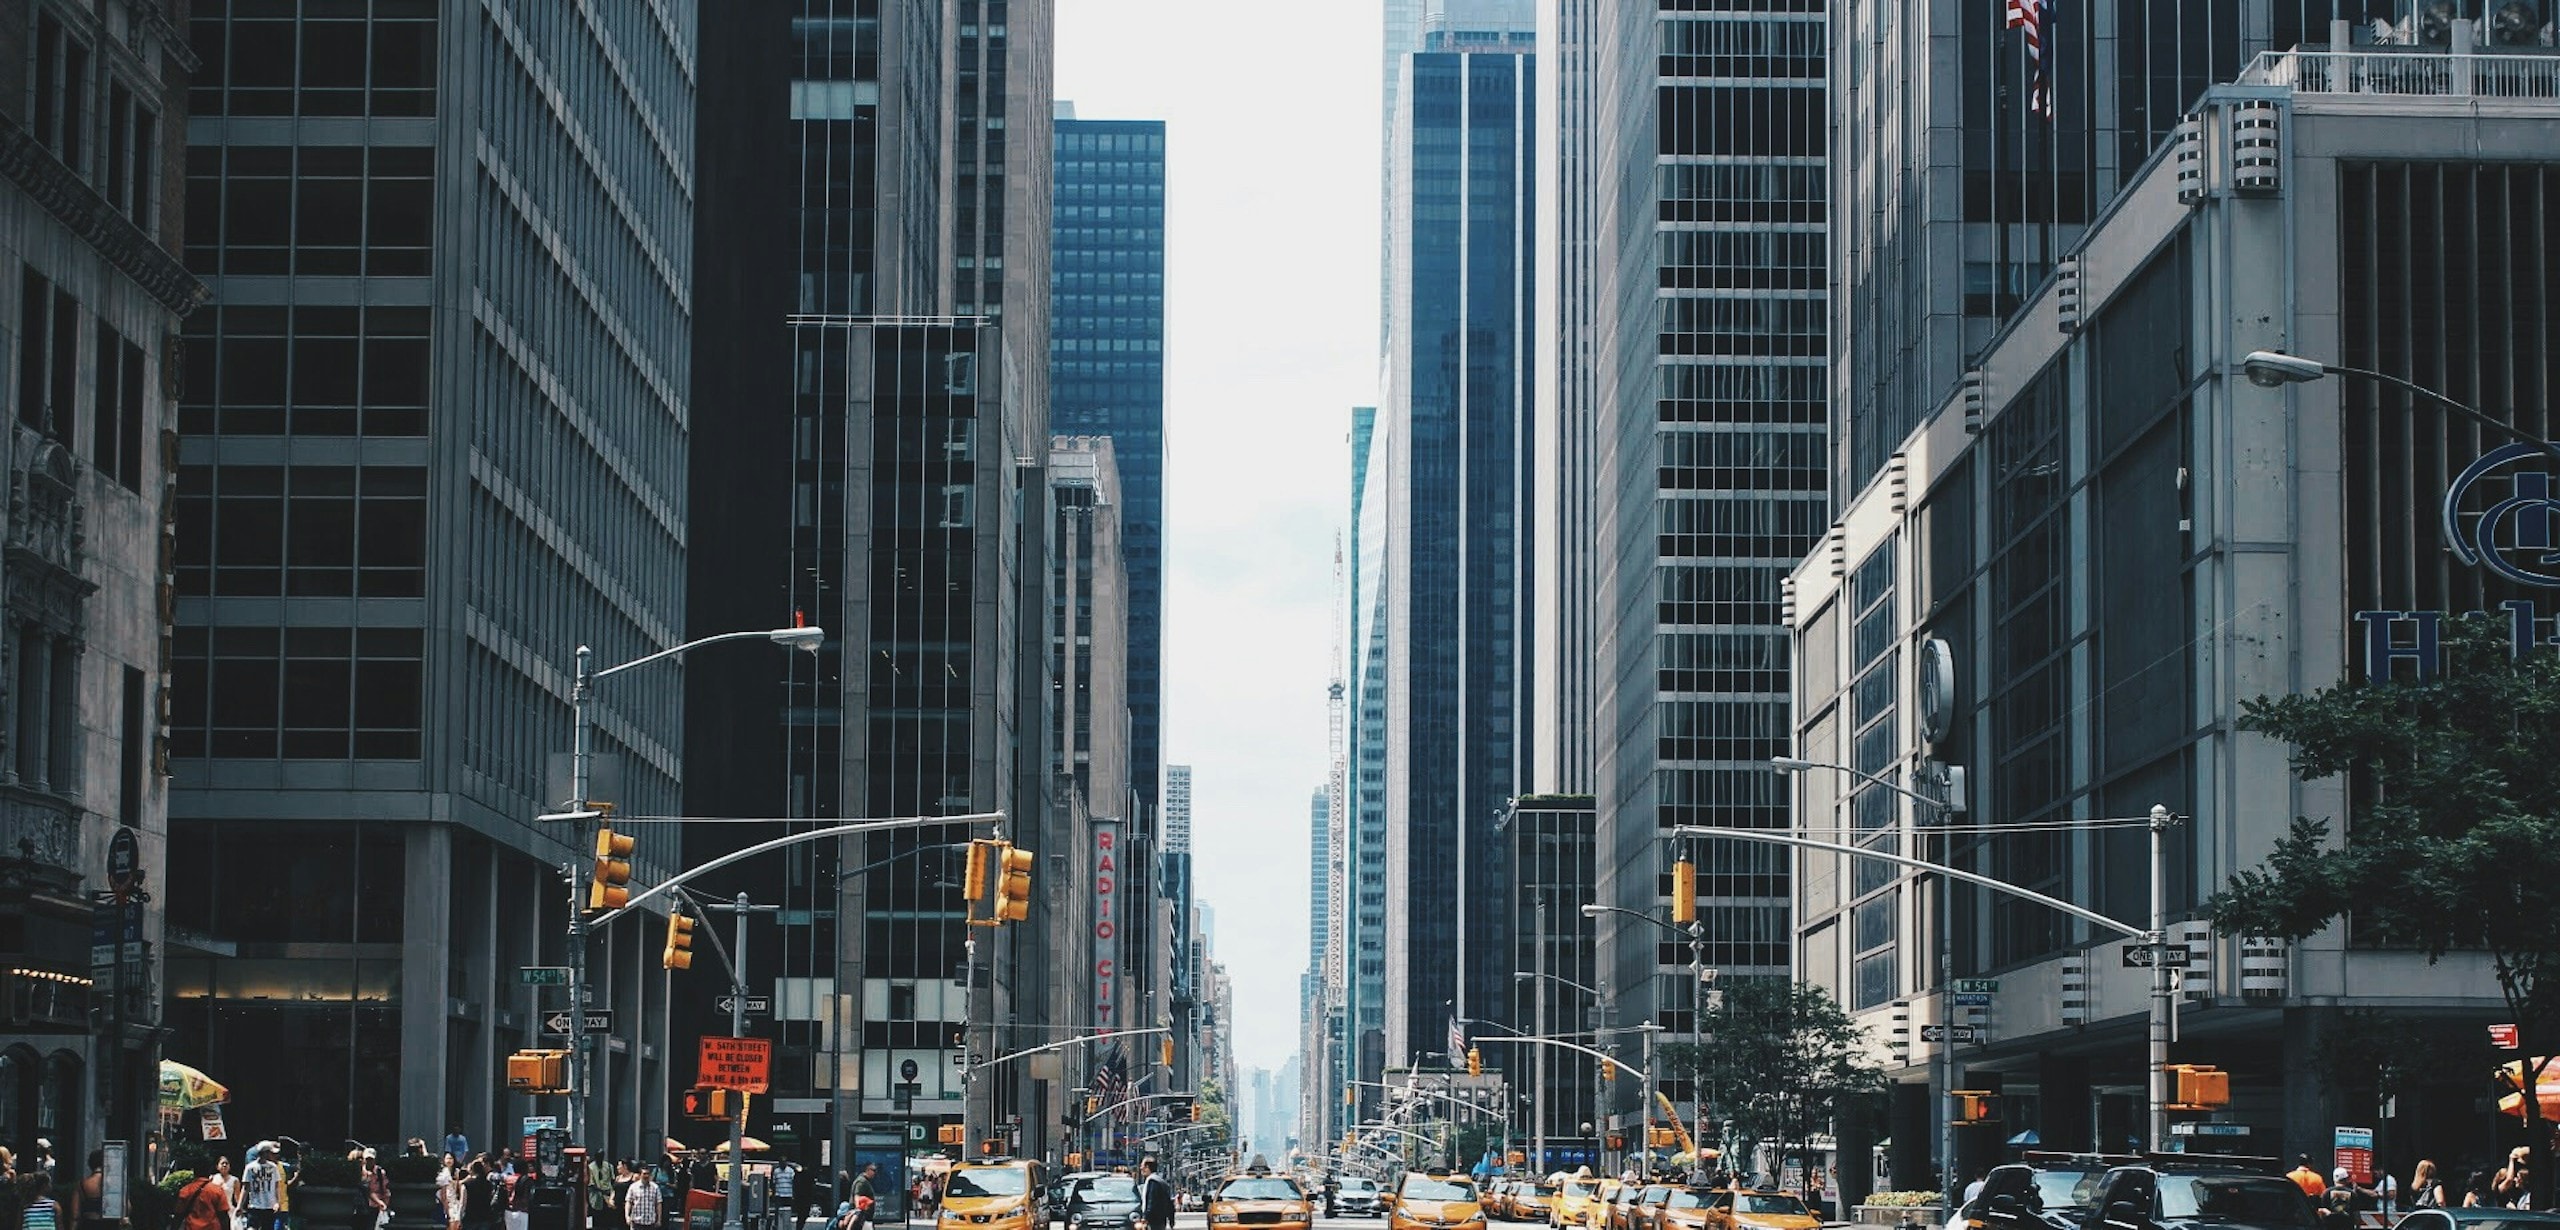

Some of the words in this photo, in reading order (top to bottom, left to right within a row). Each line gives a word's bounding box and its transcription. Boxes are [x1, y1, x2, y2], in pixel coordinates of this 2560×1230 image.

[1096, 833, 1114, 938] RADIO
[2133, 952, 2153, 961] ONE
[2165, 952, 2181, 961] AY
[523, 970, 531, 982] W
[533, 970, 546, 983] 54
[1975, 981, 1987, 992] 54
[1096, 960, 1113, 1045] CITY
[555, 1018, 570, 1028] ON
[738, 1043, 767, 1052] STREET
[708, 1053, 723, 1061] WILL
[725, 1053, 735, 1062] BE
[736, 1054, 763, 1063] CLOSED
[719, 1064, 750, 1073] BETWEEN
